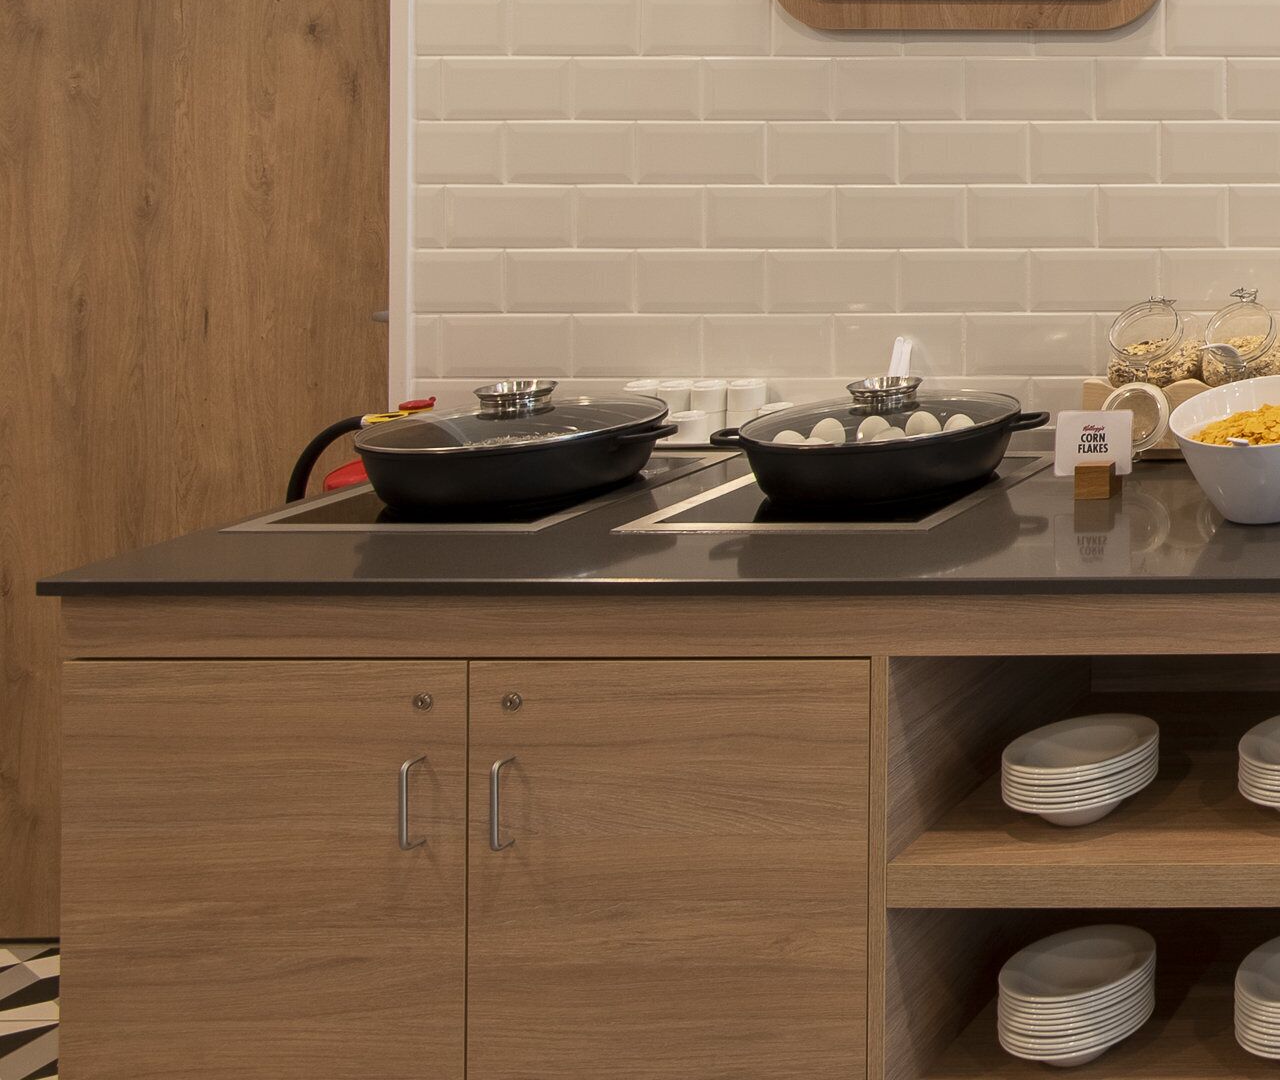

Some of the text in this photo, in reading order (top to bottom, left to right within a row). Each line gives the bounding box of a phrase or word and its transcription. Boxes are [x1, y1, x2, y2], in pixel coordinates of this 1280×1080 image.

[1083, 424, 1105, 432] Kellogg's
[1081, 433, 1105, 443] CORN
[1078, 444, 1108, 453] FLAKES
